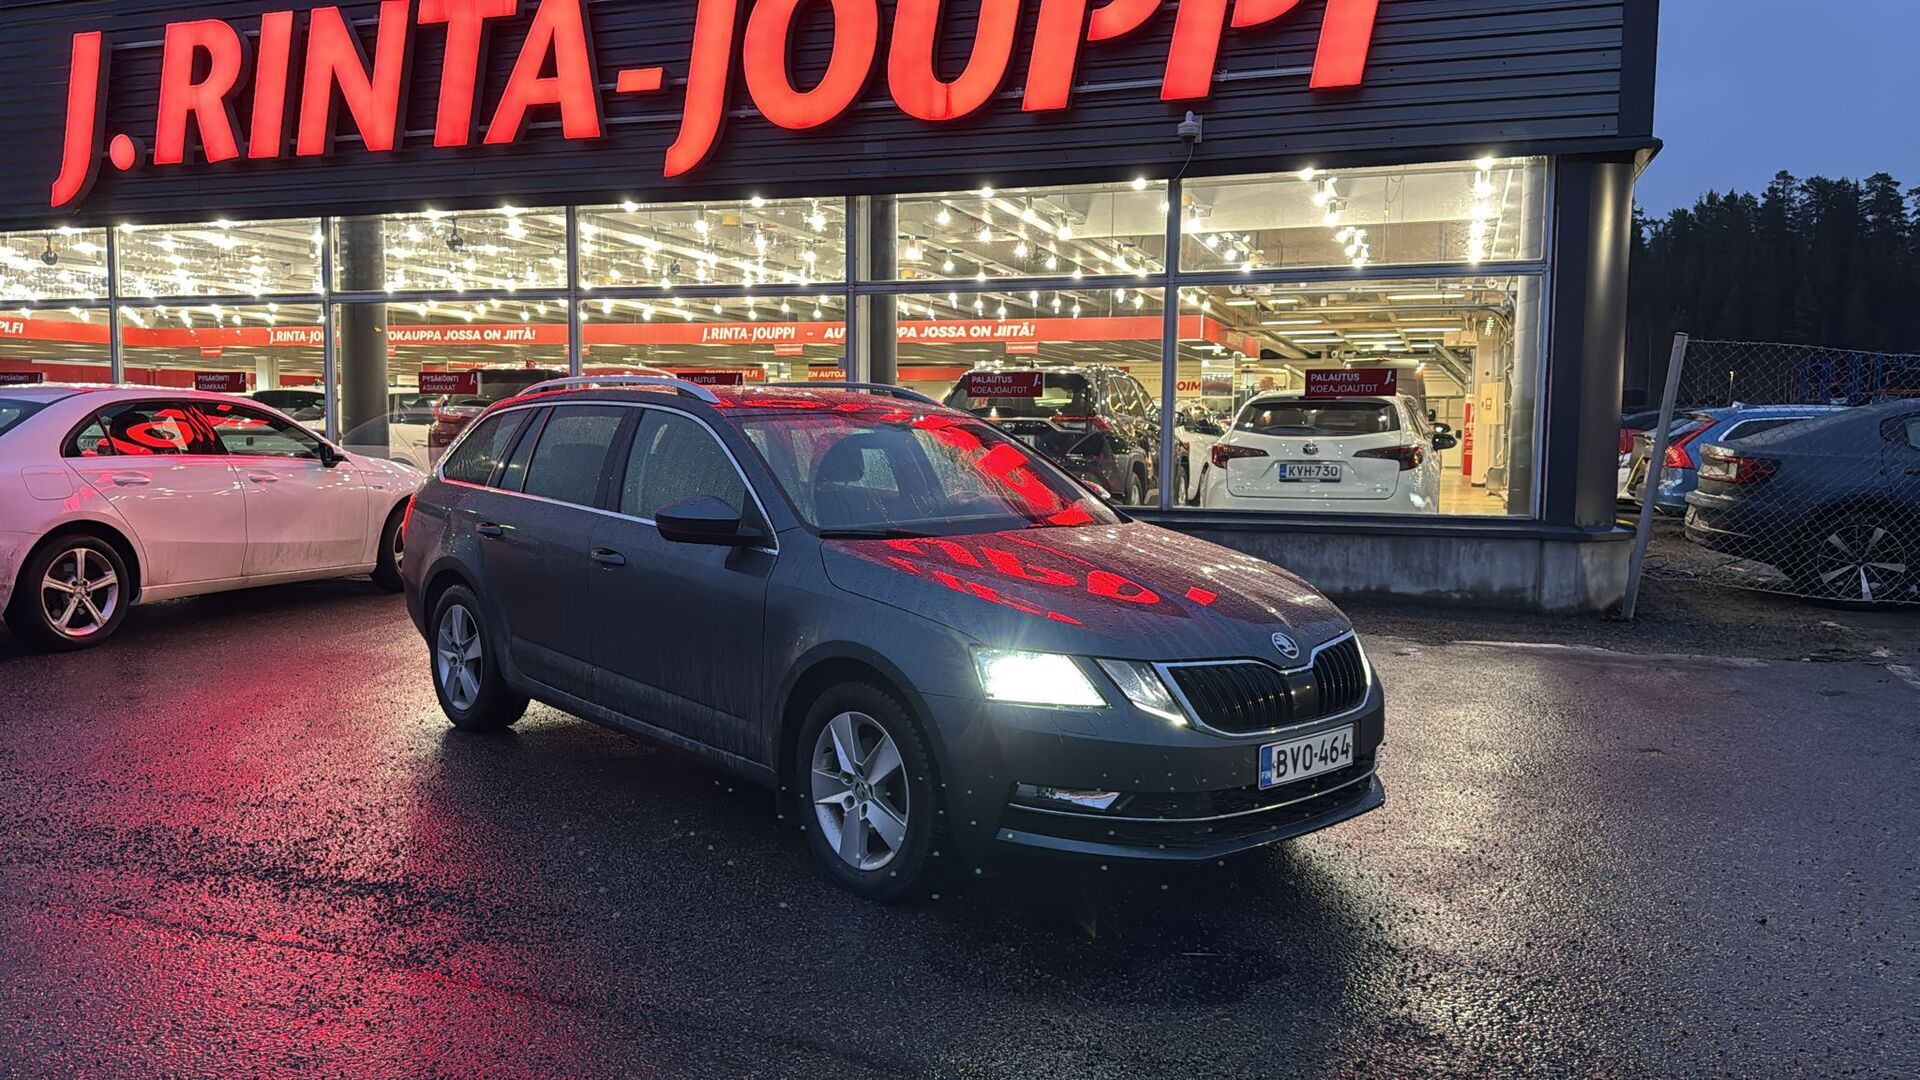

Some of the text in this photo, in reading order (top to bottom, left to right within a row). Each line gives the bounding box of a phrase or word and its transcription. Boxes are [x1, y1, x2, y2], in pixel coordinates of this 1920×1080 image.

[444, 330, 480, 340] JOSSA
[484, 329, 500, 340] ON
[702, 327, 795, 342] J.RINTA-JOUPPI
[920, 326, 965, 338] JOSSA
[970, 325, 991, 337] ON
[1311, 374, 1360, 382] PALAUTUS
[1310, 384, 1378, 393] KOEAJOAUTOT
[1276, 733, 1350, 778] BVO-464
